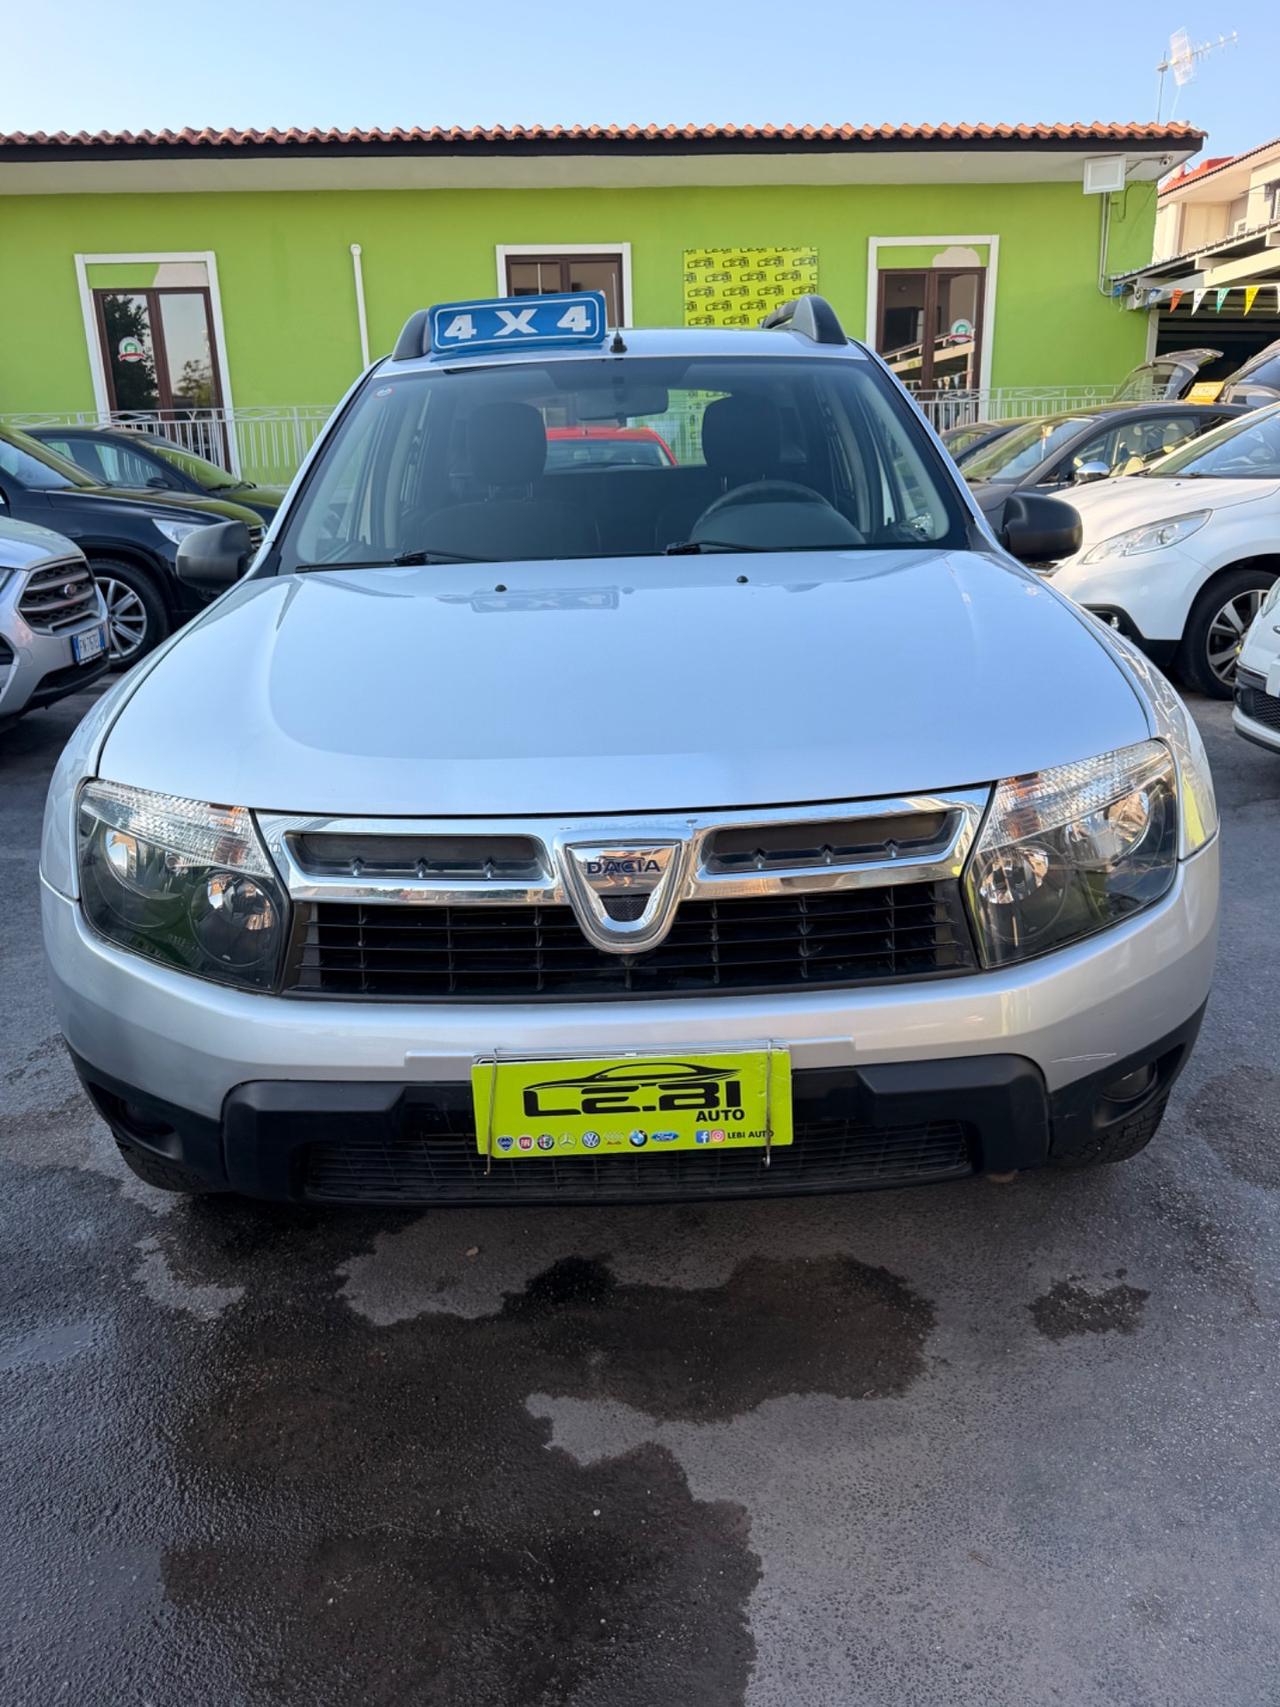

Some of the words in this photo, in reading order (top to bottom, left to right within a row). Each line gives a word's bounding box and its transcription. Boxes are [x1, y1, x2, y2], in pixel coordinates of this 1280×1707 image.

[444, 314, 477, 340] 4
[493, 308, 539, 337] X
[557, 305, 592, 332] 4
[587, 859, 661, 874] DACIA
[695, 1108, 745, 1122] AUTO
[727, 1131, 745, 1139] LEBI
